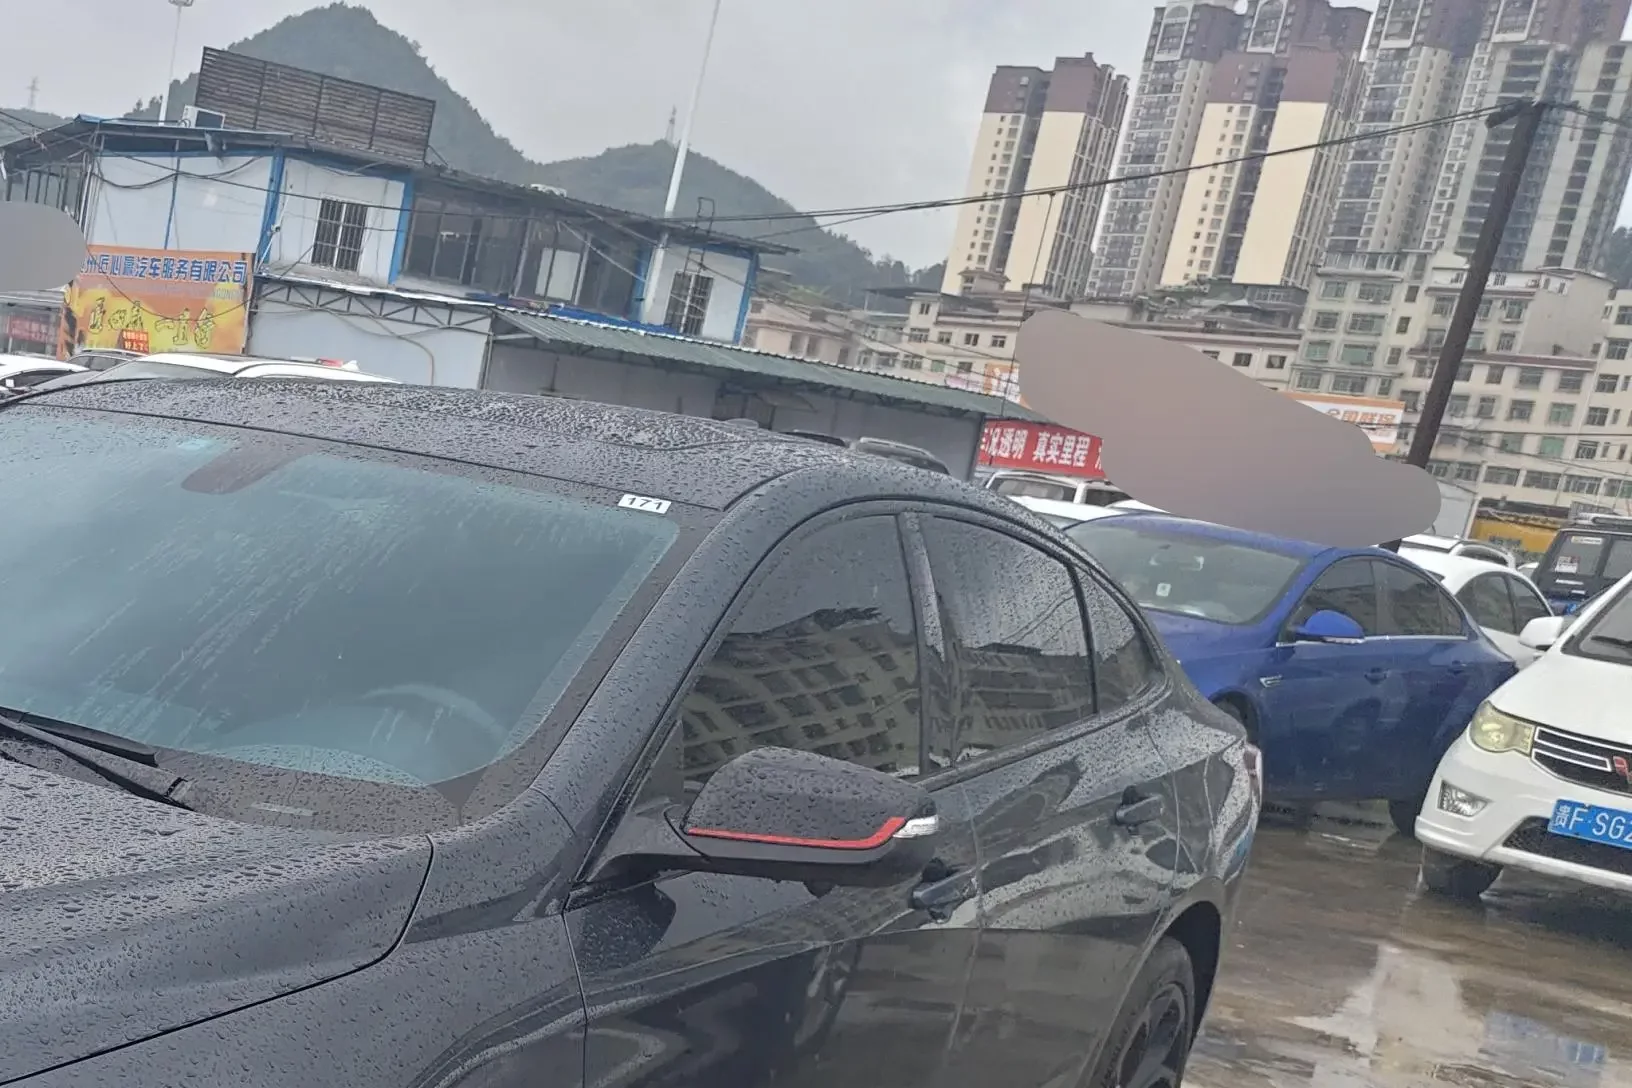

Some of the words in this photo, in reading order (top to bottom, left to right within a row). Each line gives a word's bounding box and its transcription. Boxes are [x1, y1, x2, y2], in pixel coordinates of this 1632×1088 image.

[1032, 431, 1091, 467] 真实里程
[627, 496, 664, 510] 171
